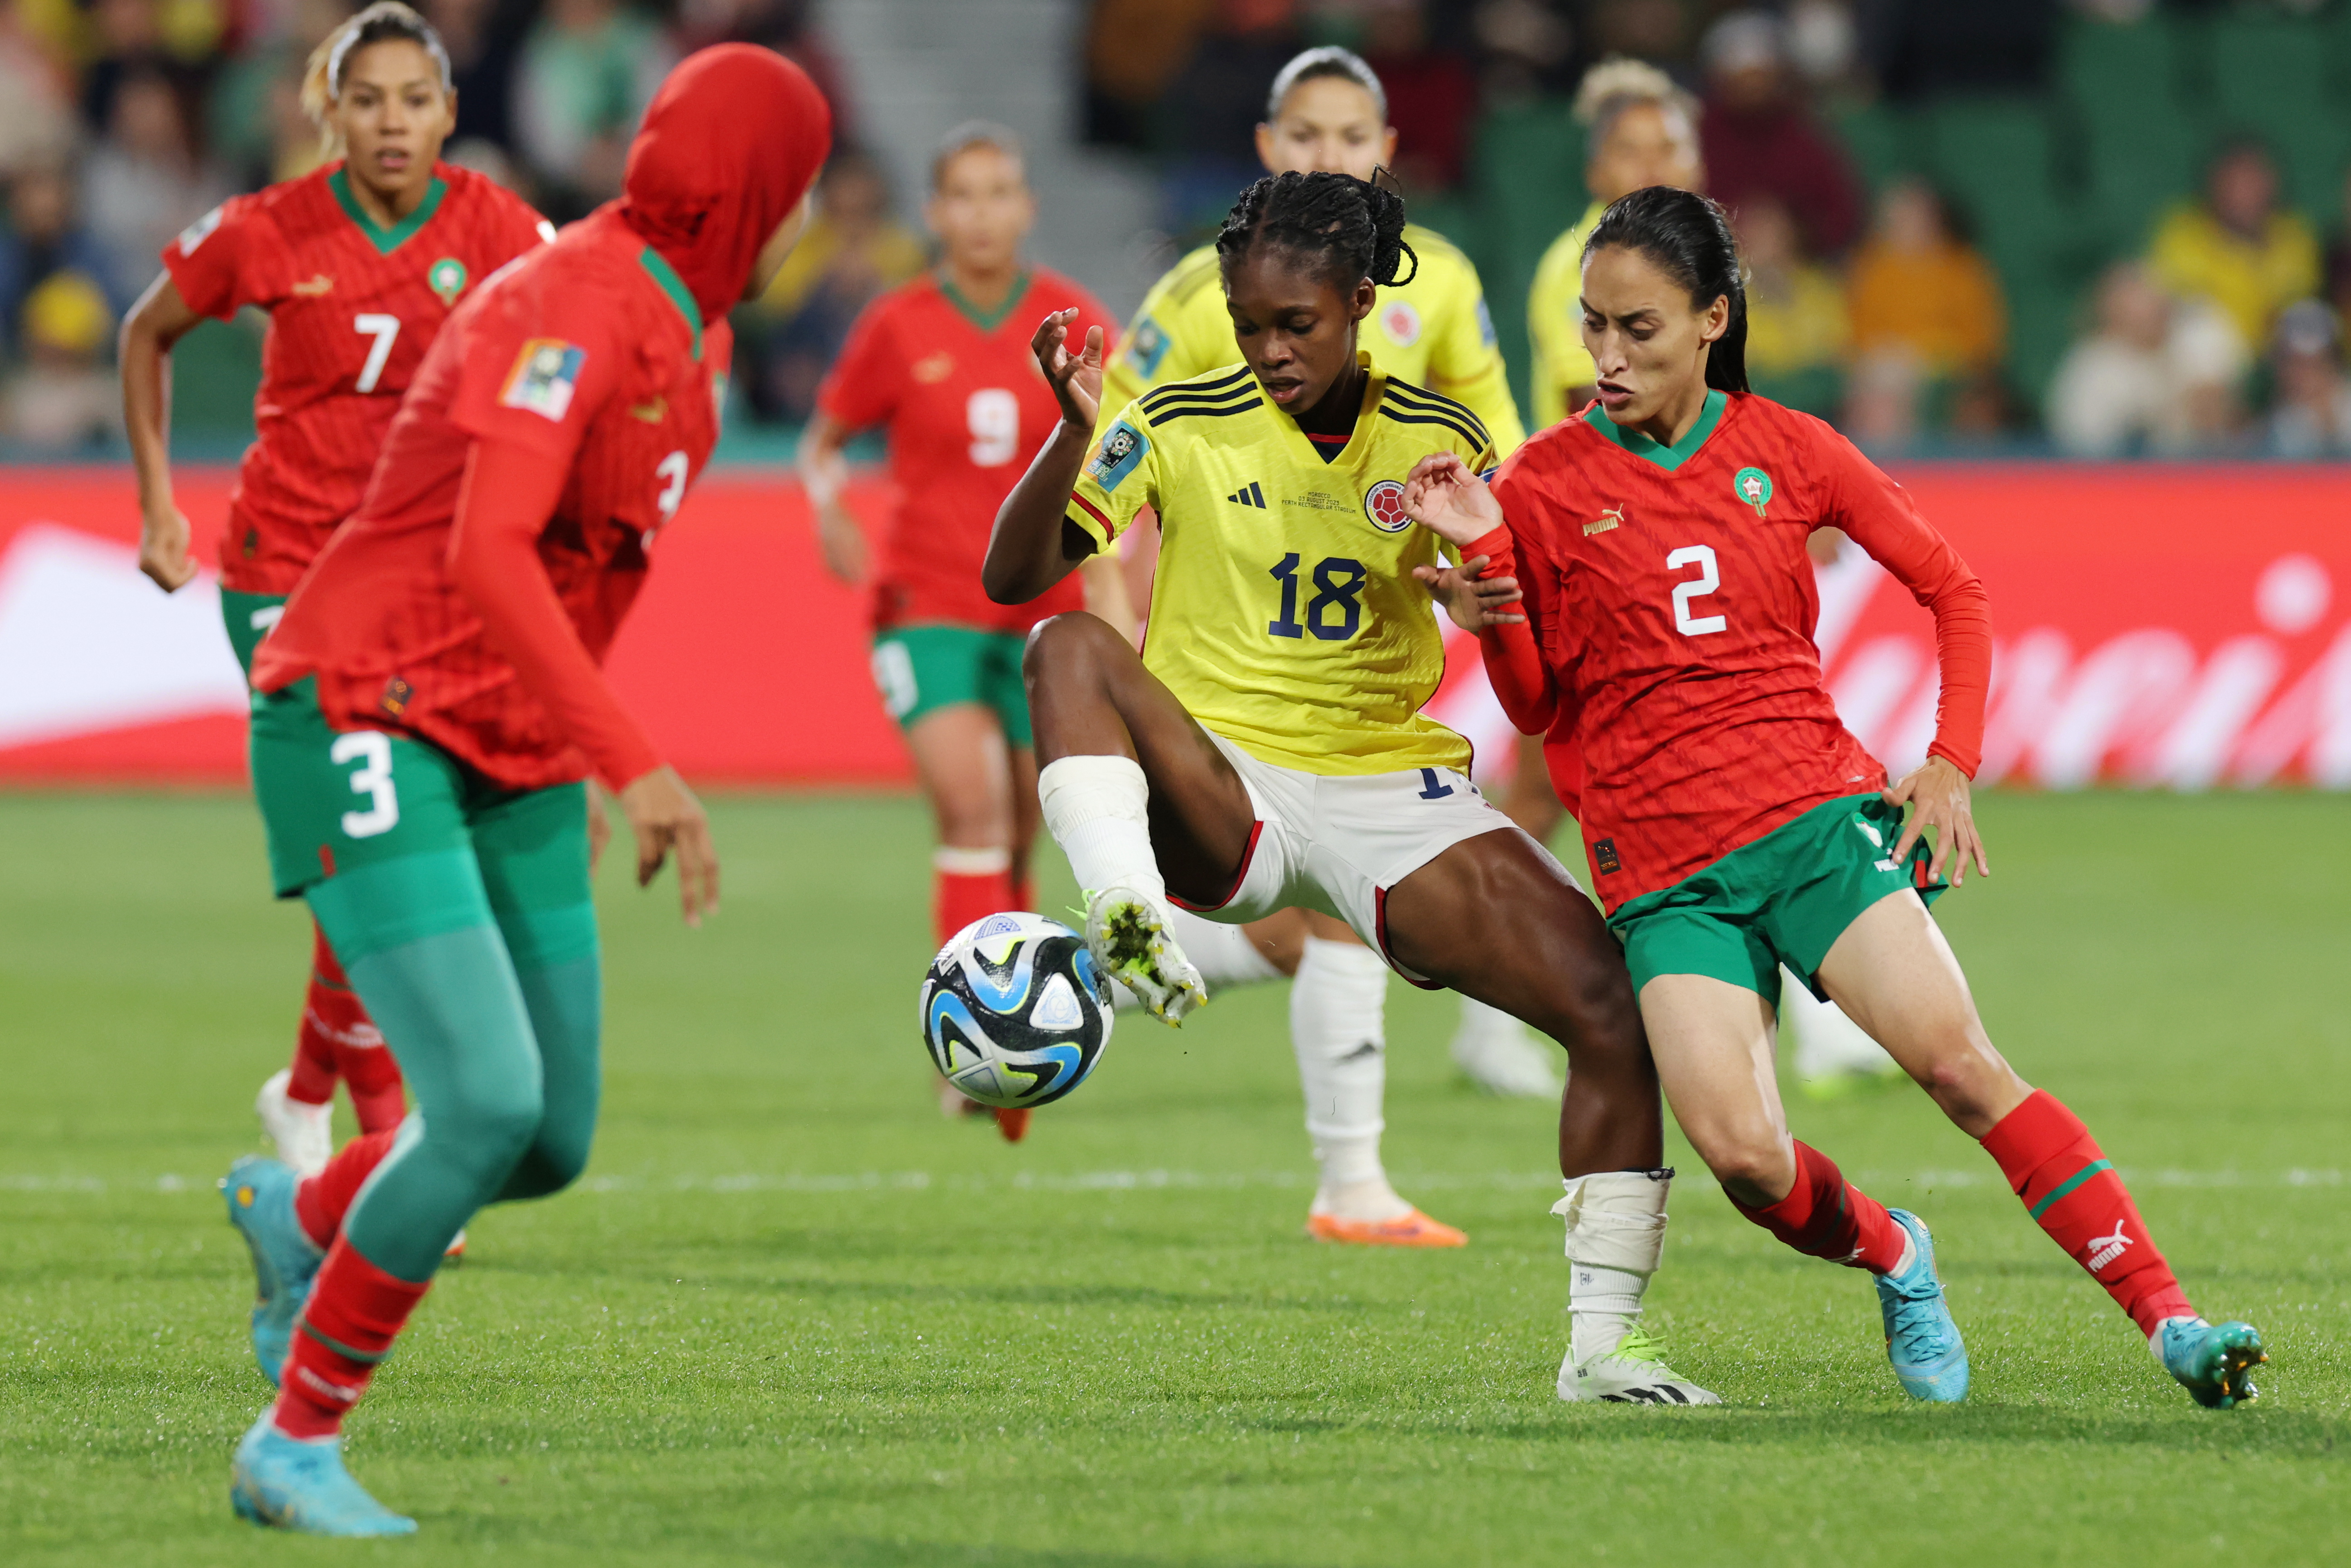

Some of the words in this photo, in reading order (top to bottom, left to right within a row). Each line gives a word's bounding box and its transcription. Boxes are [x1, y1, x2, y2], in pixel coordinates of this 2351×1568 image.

[354, 313, 401, 393] 7
[967, 388, 1020, 468] 9
[1298, 501, 1333, 510] RECTANGULAR
[1268, 552, 1367, 640] 18
[1666, 545, 1727, 637] 2
[871, 640, 918, 719] 9
[330, 730, 399, 839] 3
[2087, 1241, 2126, 1273] PUMA
